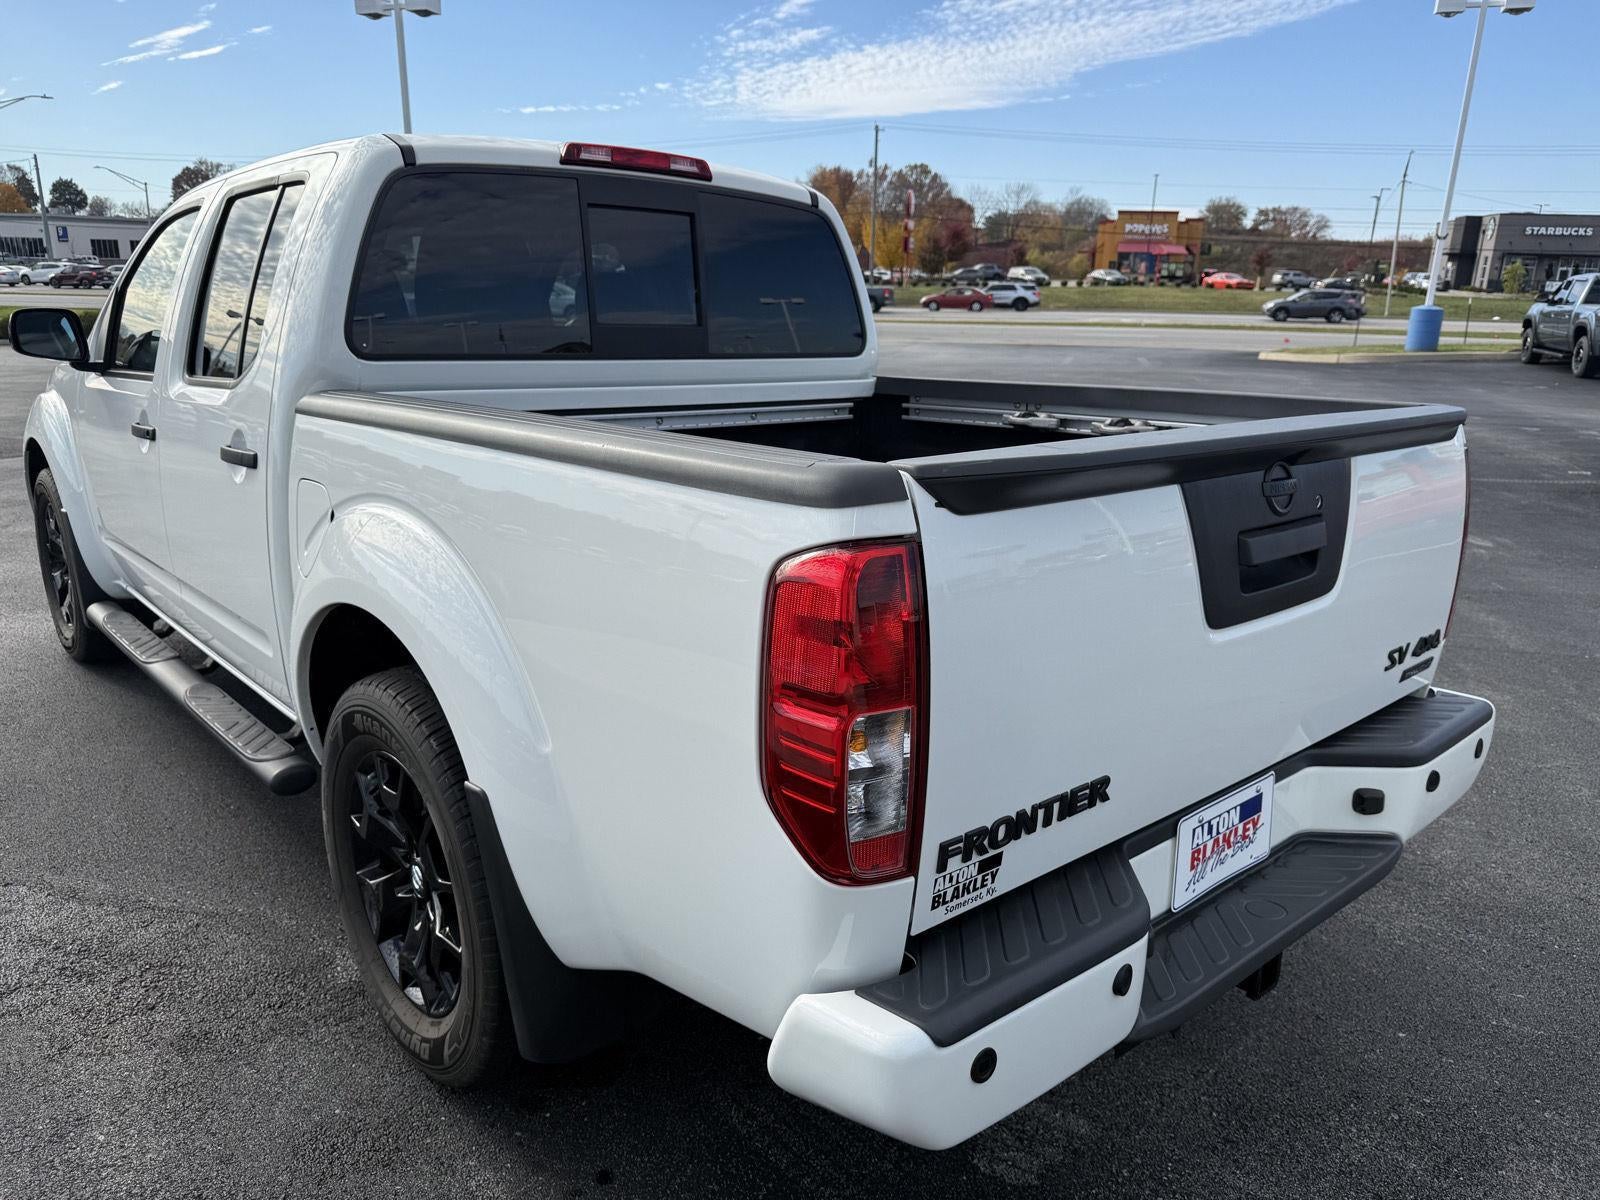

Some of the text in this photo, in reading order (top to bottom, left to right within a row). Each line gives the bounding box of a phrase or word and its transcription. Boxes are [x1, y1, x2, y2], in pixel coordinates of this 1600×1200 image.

[1524, 226, 1594, 236] STARBUCKS
[1384, 642, 1411, 672] SV
[936, 775, 1111, 874] FRONTIER
[1192, 806, 1241, 848] ALTON
[1189, 815, 1261, 872] BLAKLEY
[930, 868, 1000, 911] BLAKLEY
[933, 861, 979, 894] ALTON
[944, 886, 997, 915] Somerset, Ky.
